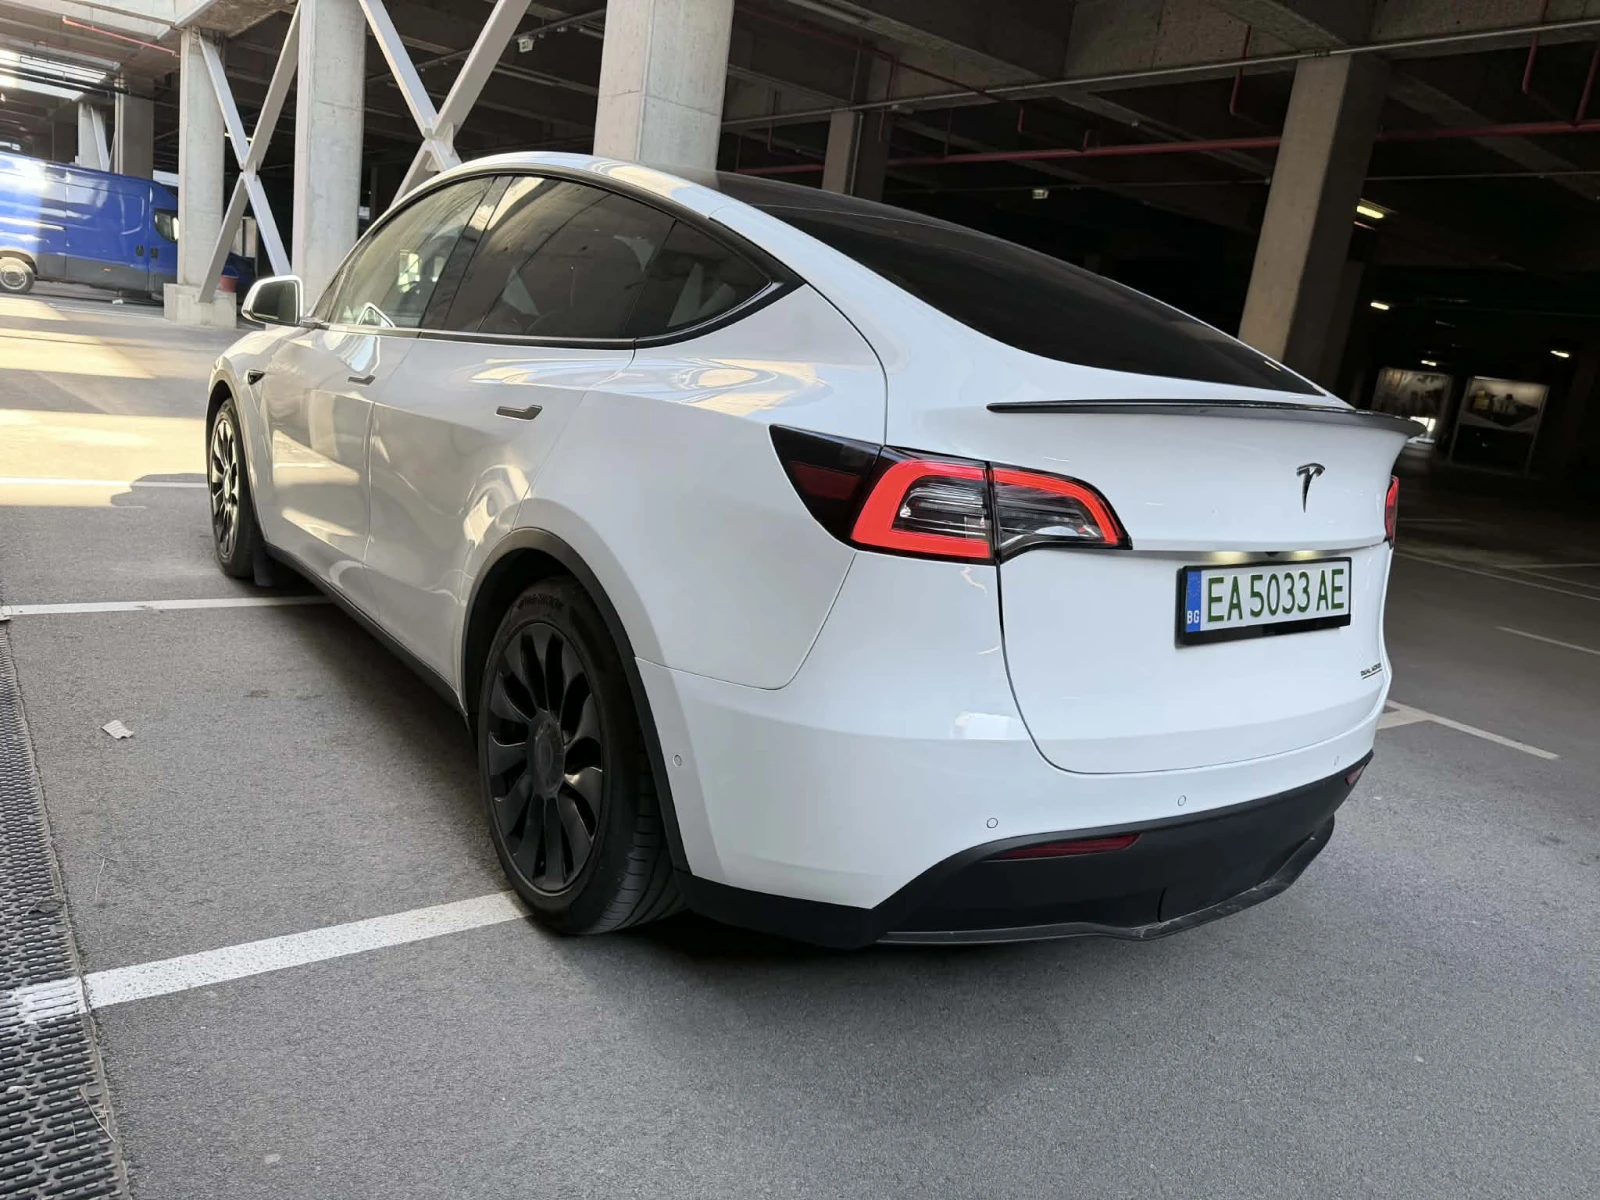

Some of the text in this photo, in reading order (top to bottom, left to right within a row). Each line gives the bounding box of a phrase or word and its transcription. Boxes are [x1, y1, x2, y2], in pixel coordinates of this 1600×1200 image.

[1208, 568, 1345, 622] EA 5033 AE
[1187, 610, 1200, 624] BG
